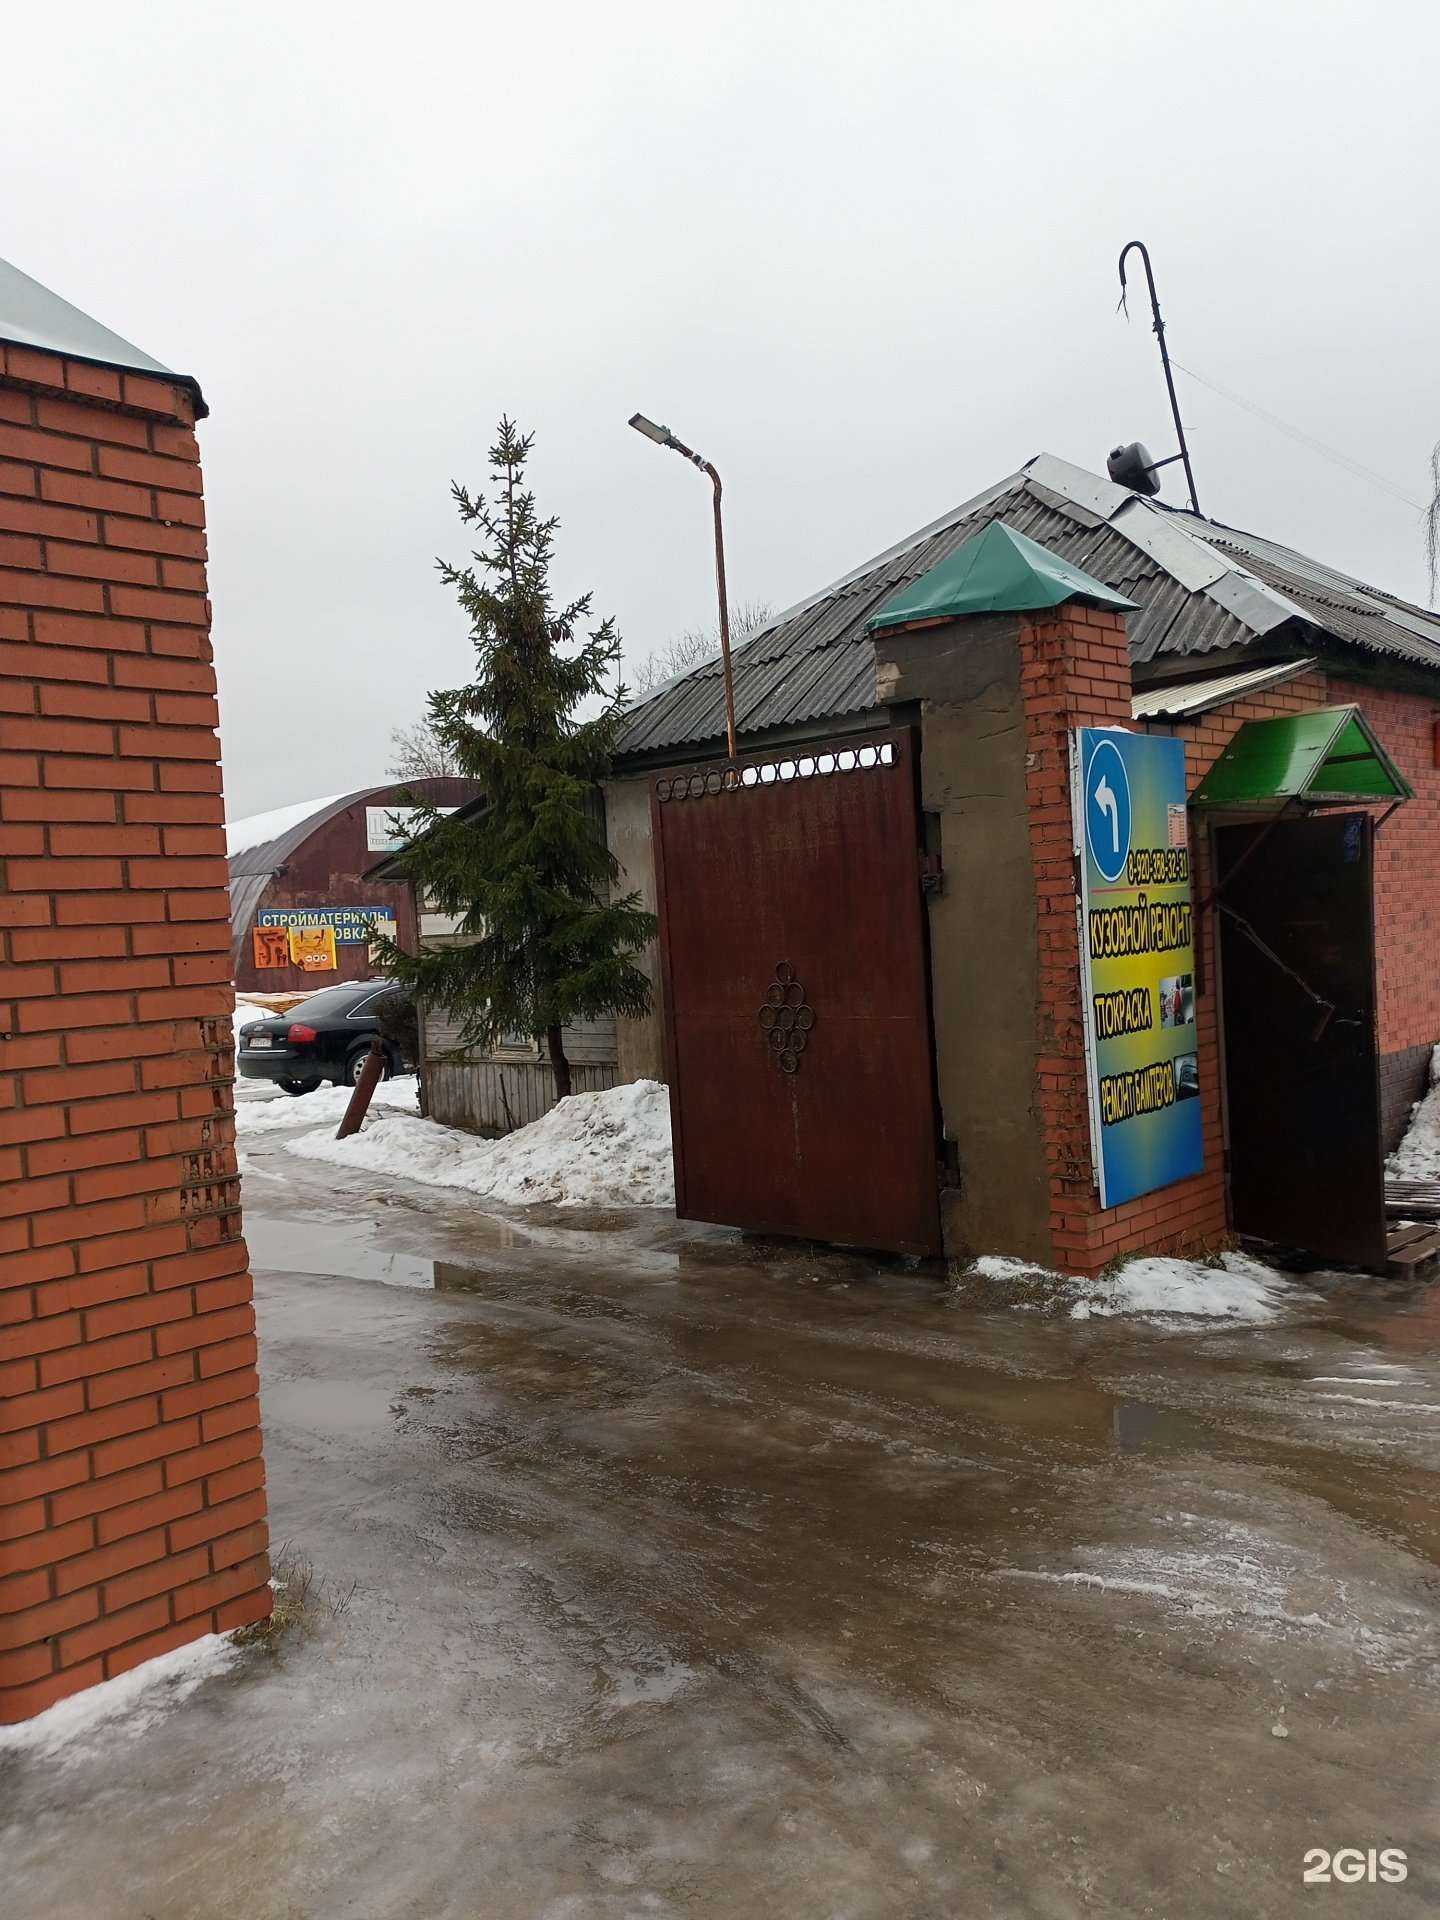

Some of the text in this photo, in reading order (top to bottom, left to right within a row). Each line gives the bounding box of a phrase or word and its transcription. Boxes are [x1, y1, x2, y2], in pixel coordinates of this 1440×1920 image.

[262, 910, 389, 927] СТРОЙМАТЕРИАЛЫ
[1089, 893, 1191, 958] КУЗОВНОЙ РЕМОНТ
[1094, 988, 1152, 1040] ПОКРАСКА
[1100, 1060, 1174, 1126] РЕМОНТ БАМПЕРОВ
